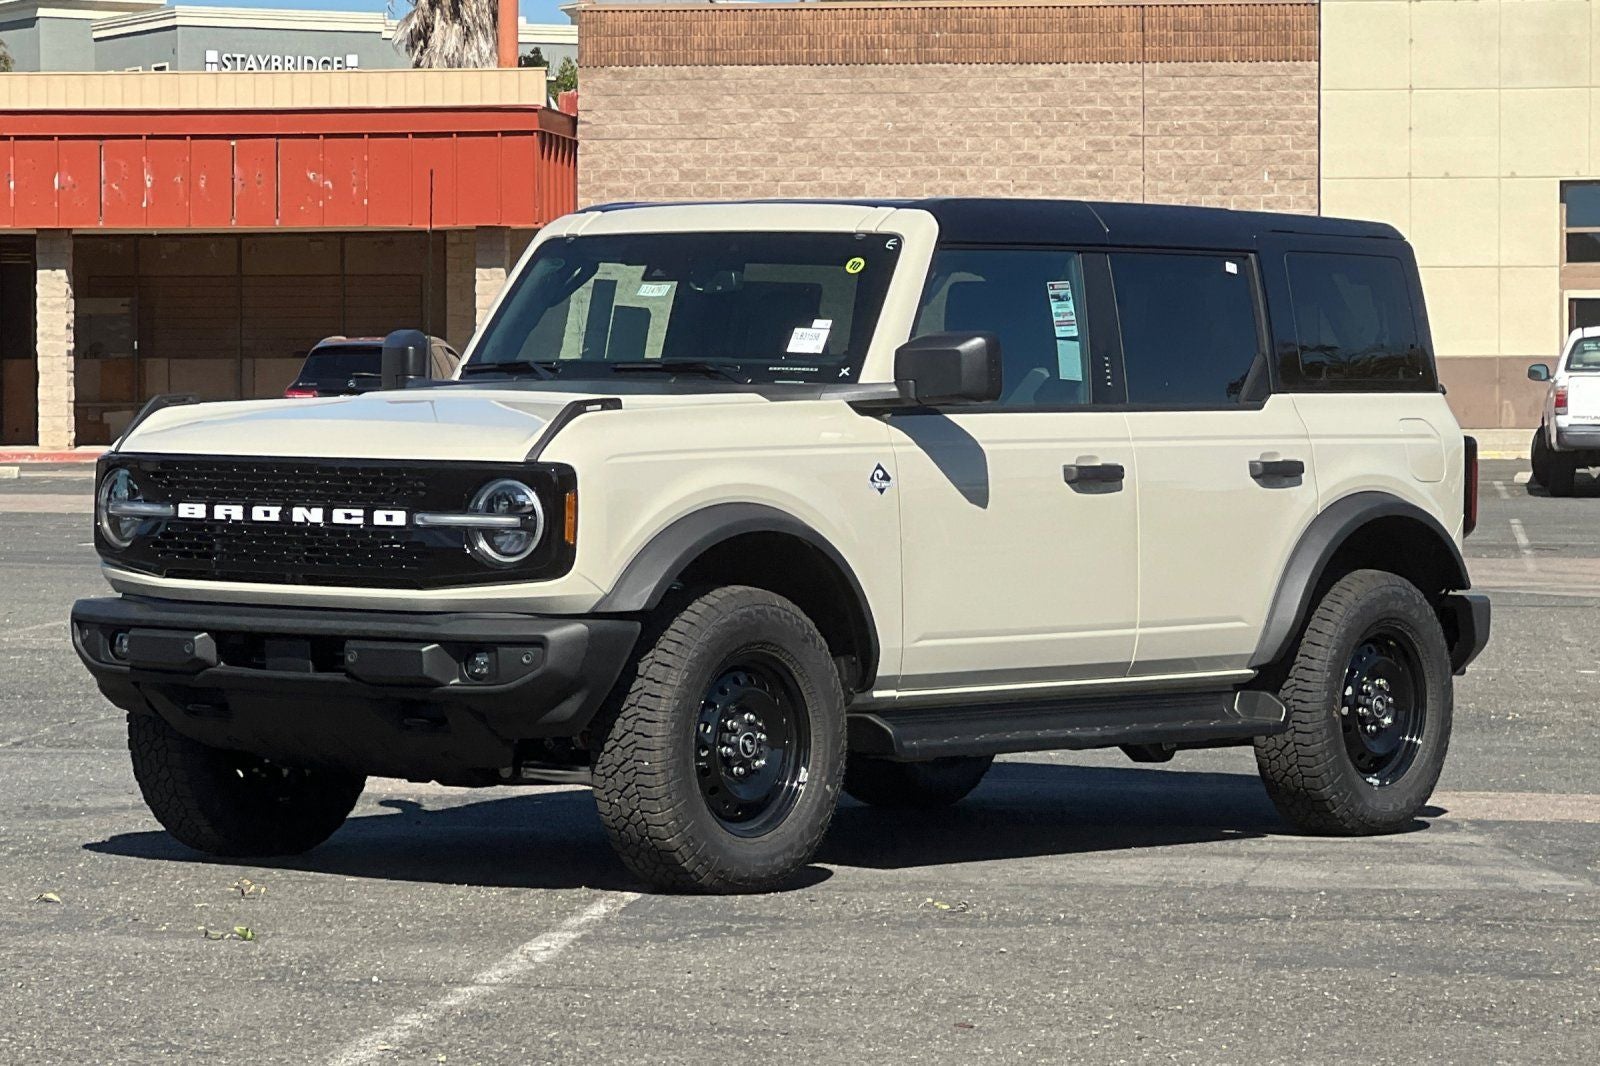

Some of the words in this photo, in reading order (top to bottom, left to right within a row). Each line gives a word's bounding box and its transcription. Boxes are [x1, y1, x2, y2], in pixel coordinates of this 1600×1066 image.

[221, 53, 343, 71] STAYBRIDGE
[849, 260, 861, 271] 10
[178, 503, 407, 526] BRONCO
